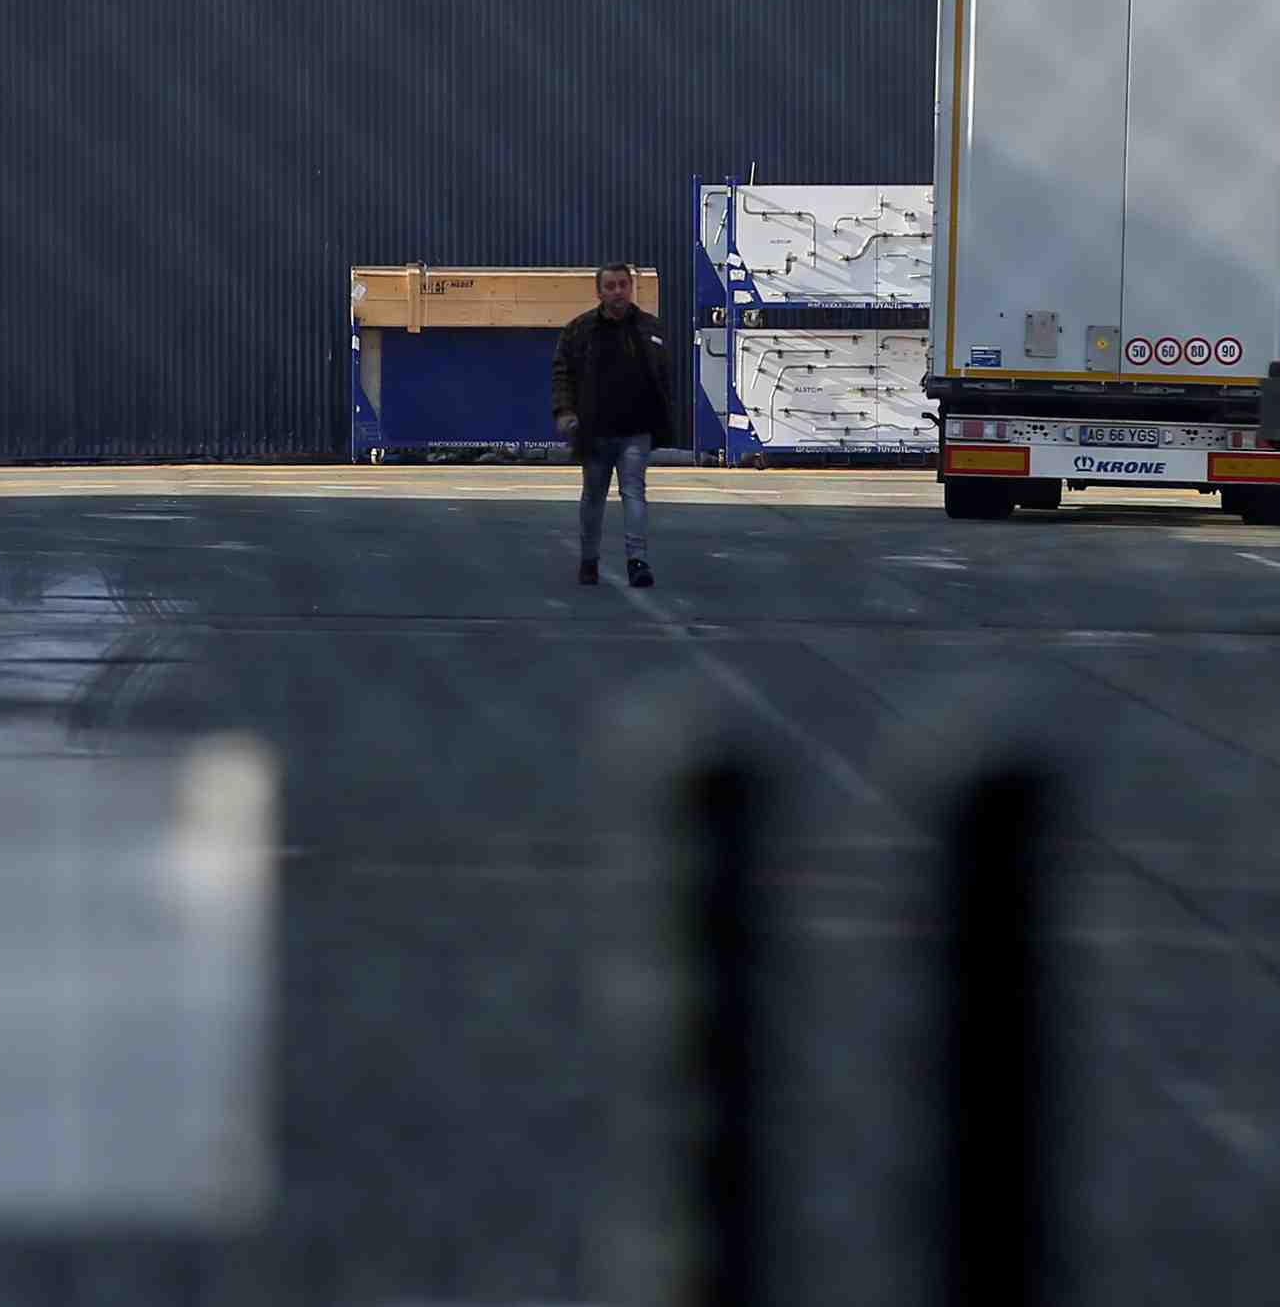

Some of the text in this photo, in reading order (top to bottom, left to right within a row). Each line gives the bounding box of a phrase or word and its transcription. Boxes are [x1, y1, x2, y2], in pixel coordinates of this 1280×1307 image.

[1132, 344, 1146, 358] 50
[1161, 344, 1176, 358] 60
[1190, 344, 1205, 358] 80
[1221, 344, 1236, 358] 90
[1087, 428, 1105, 441] AG
[1128, 429, 1158, 443] YGS
[1095, 460, 1167, 474] KRONE
